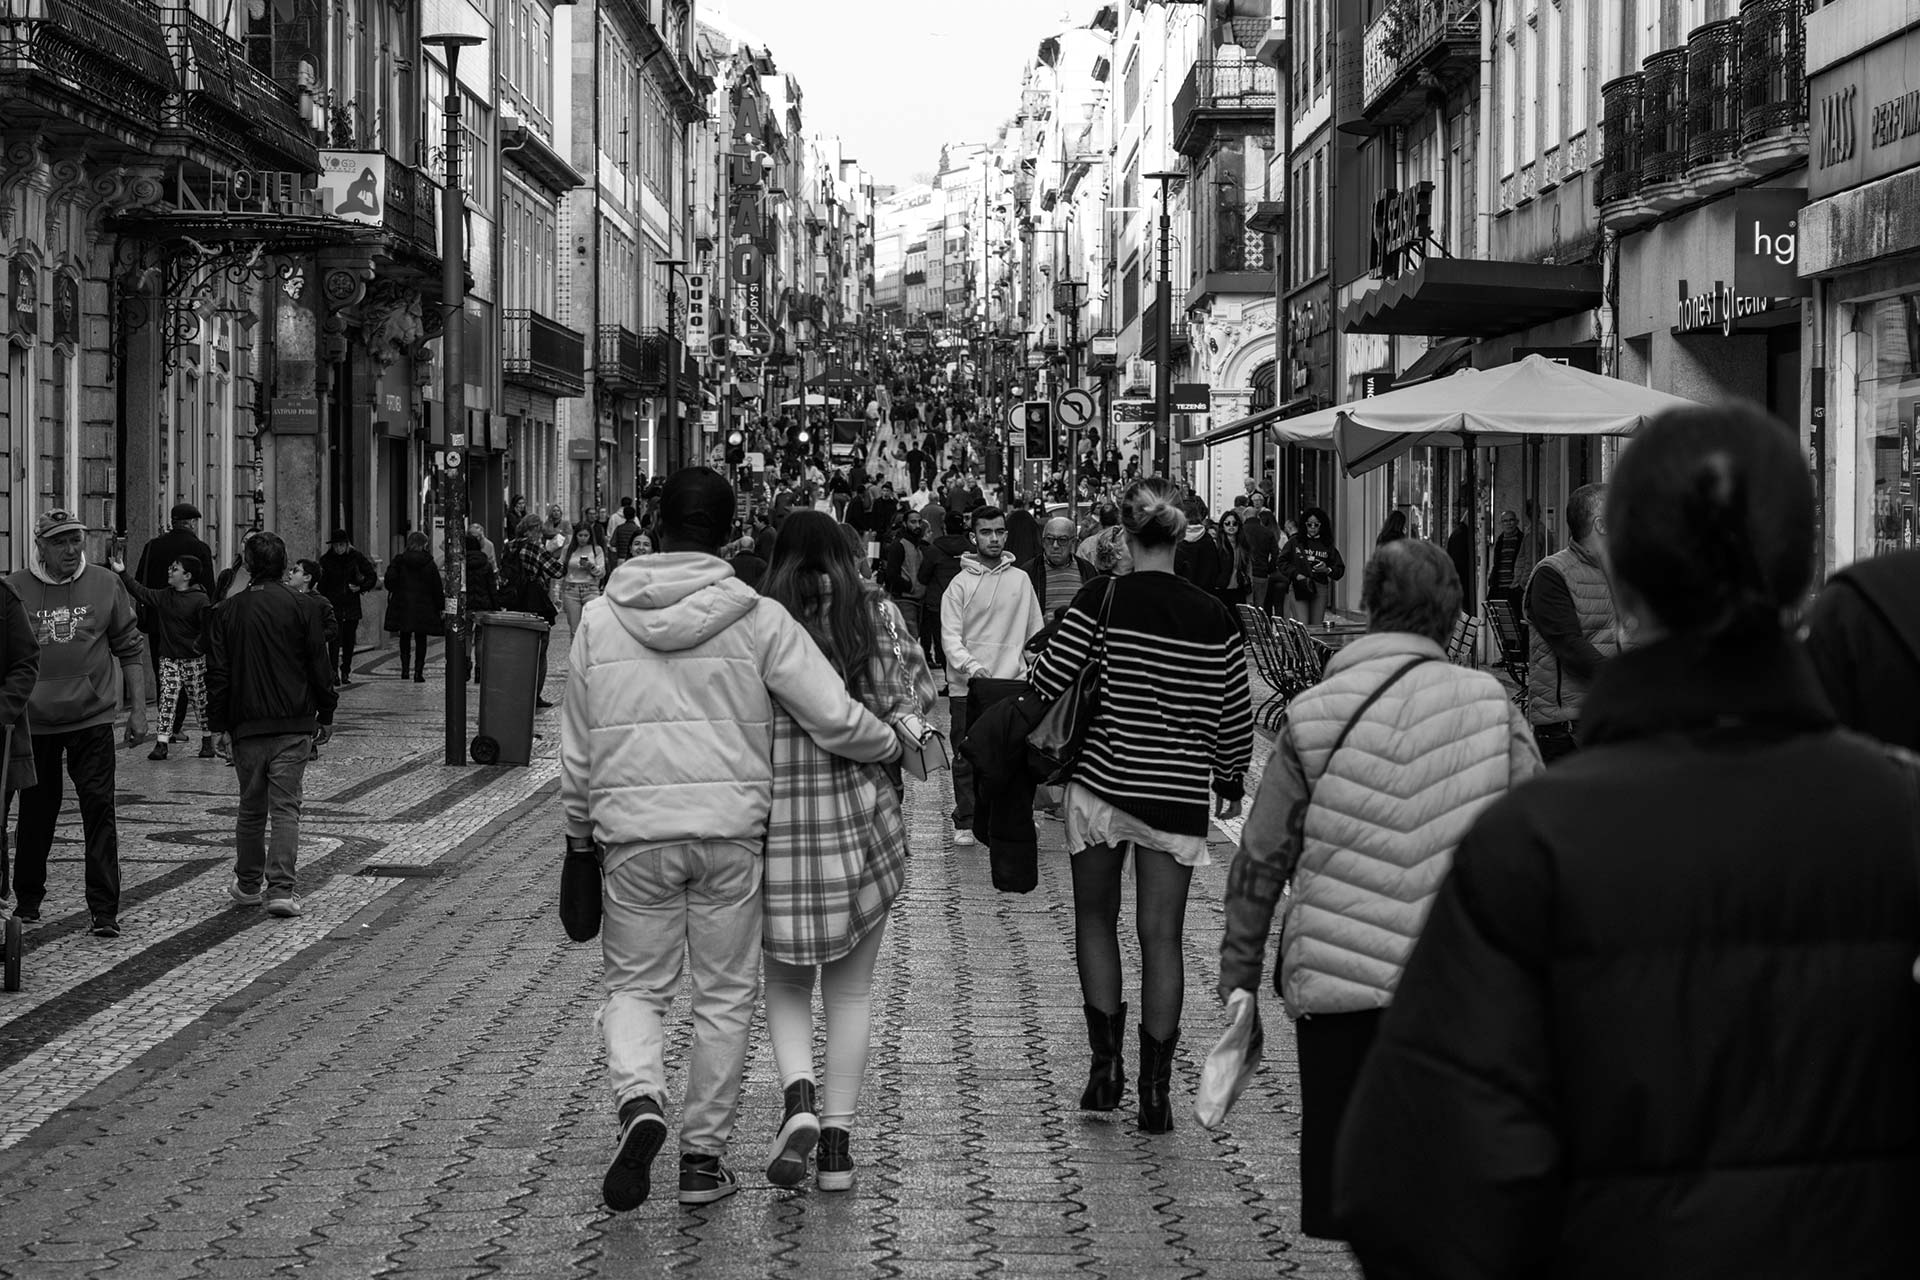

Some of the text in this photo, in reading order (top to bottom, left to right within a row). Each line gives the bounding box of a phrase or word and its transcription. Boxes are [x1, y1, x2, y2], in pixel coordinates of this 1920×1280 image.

[209, 168, 312, 205] HOTEL
[1754, 220, 1796, 265] hg
[690, 276, 703, 327] OURO
[1677, 279, 1721, 332] honest
